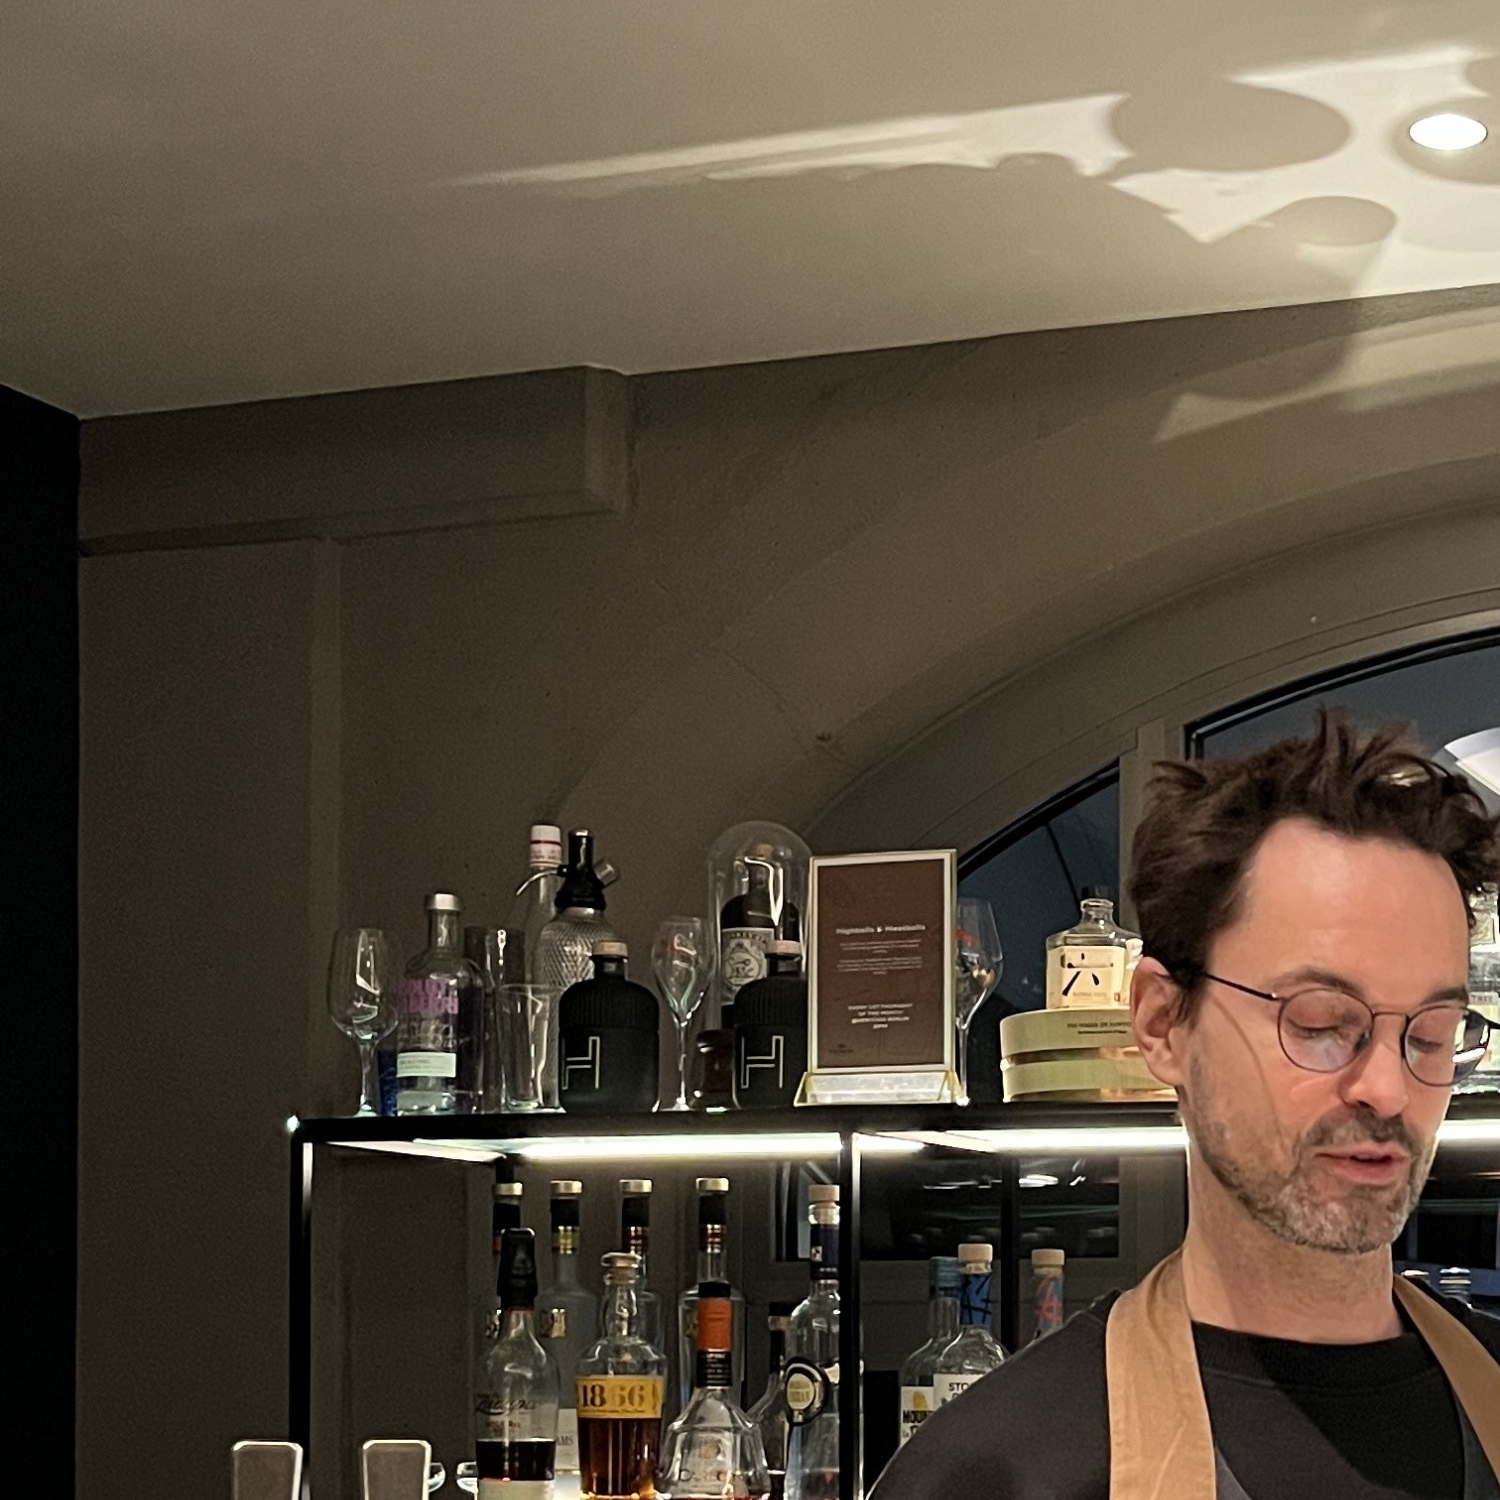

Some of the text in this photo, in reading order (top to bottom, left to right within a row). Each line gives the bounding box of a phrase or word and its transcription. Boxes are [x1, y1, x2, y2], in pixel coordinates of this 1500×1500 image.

[1061, 952, 1114, 997] 六
[948, 1382, 969, 1392] STO
[557, 1436, 574, 1447] AMS
